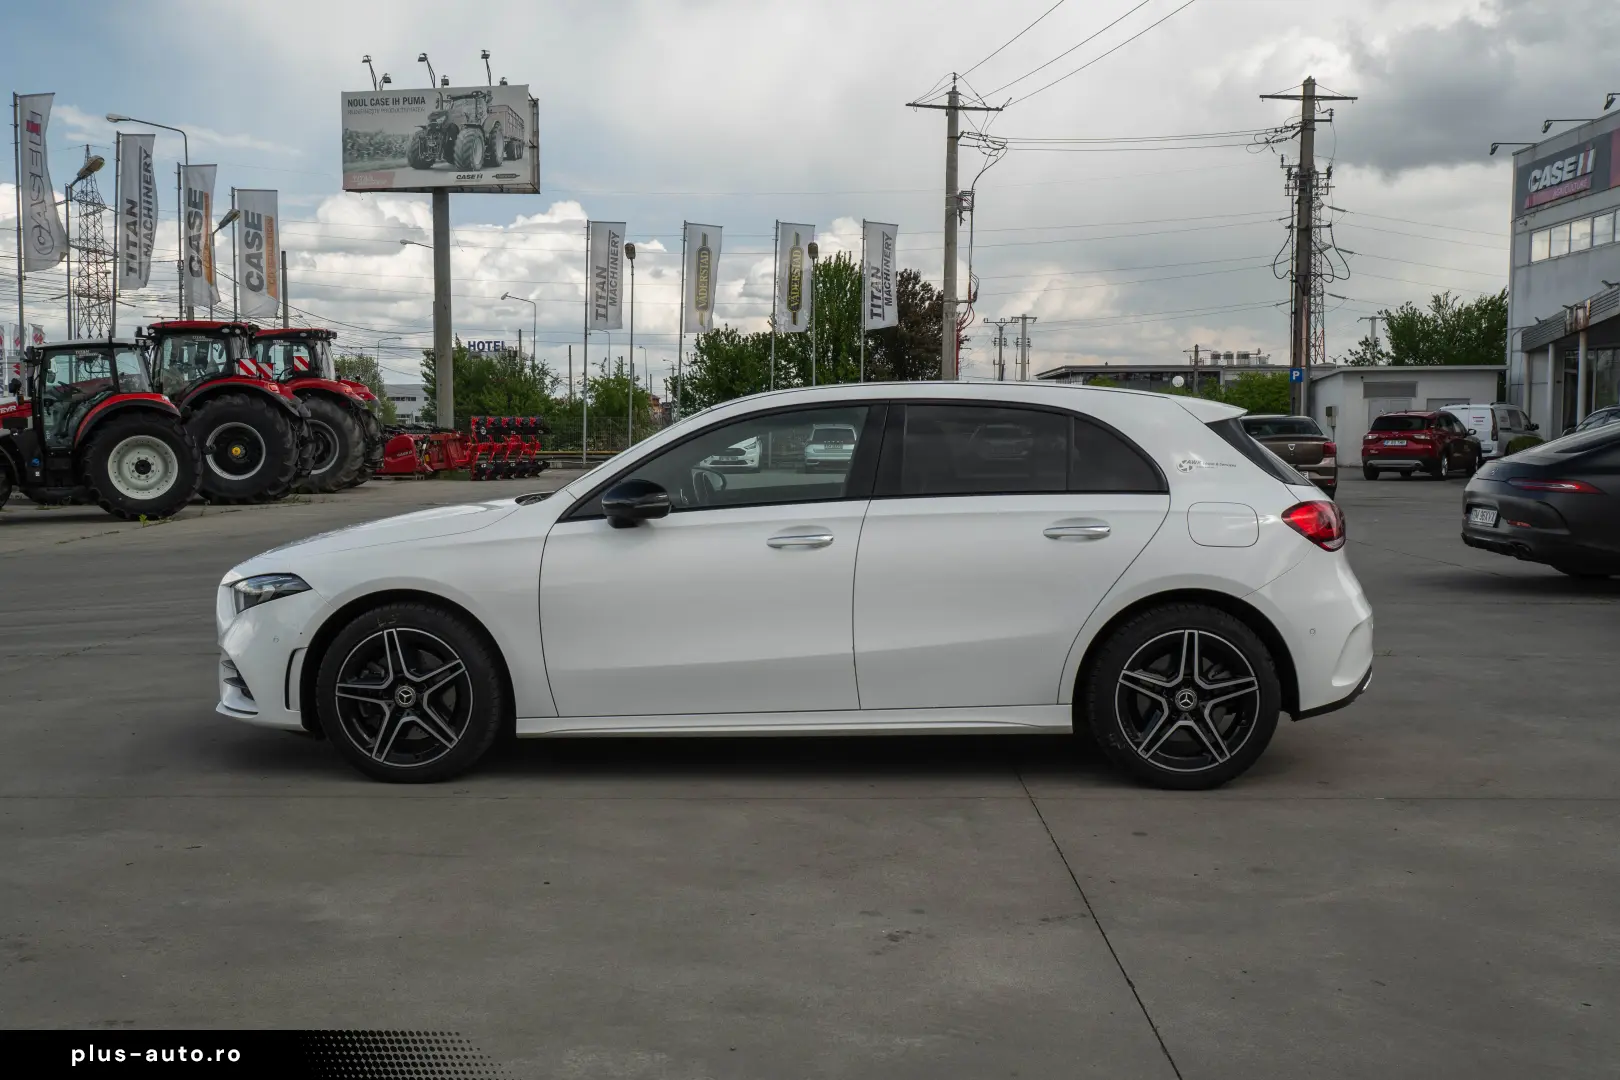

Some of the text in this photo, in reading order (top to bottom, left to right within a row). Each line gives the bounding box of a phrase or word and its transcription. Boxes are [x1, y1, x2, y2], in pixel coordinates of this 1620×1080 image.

[347, 96, 426, 107] NOUL CASE IH PUMA
[141, 149, 155, 257] MACHINERY
[1528, 155, 1578, 193] CASE
[125, 198, 138, 277] TITAN
[188, 187, 204, 278] CASE
[243, 210, 265, 293] CASE
[595, 265, 607, 321] TITAN
[608, 231, 620, 308] MACHINERY
[870, 265, 882, 321] TITAN
[883, 233, 894, 308] MACHINERY
[467, 340, 508, 352] HOTEL
[1292, 370, 1300, 380] P
